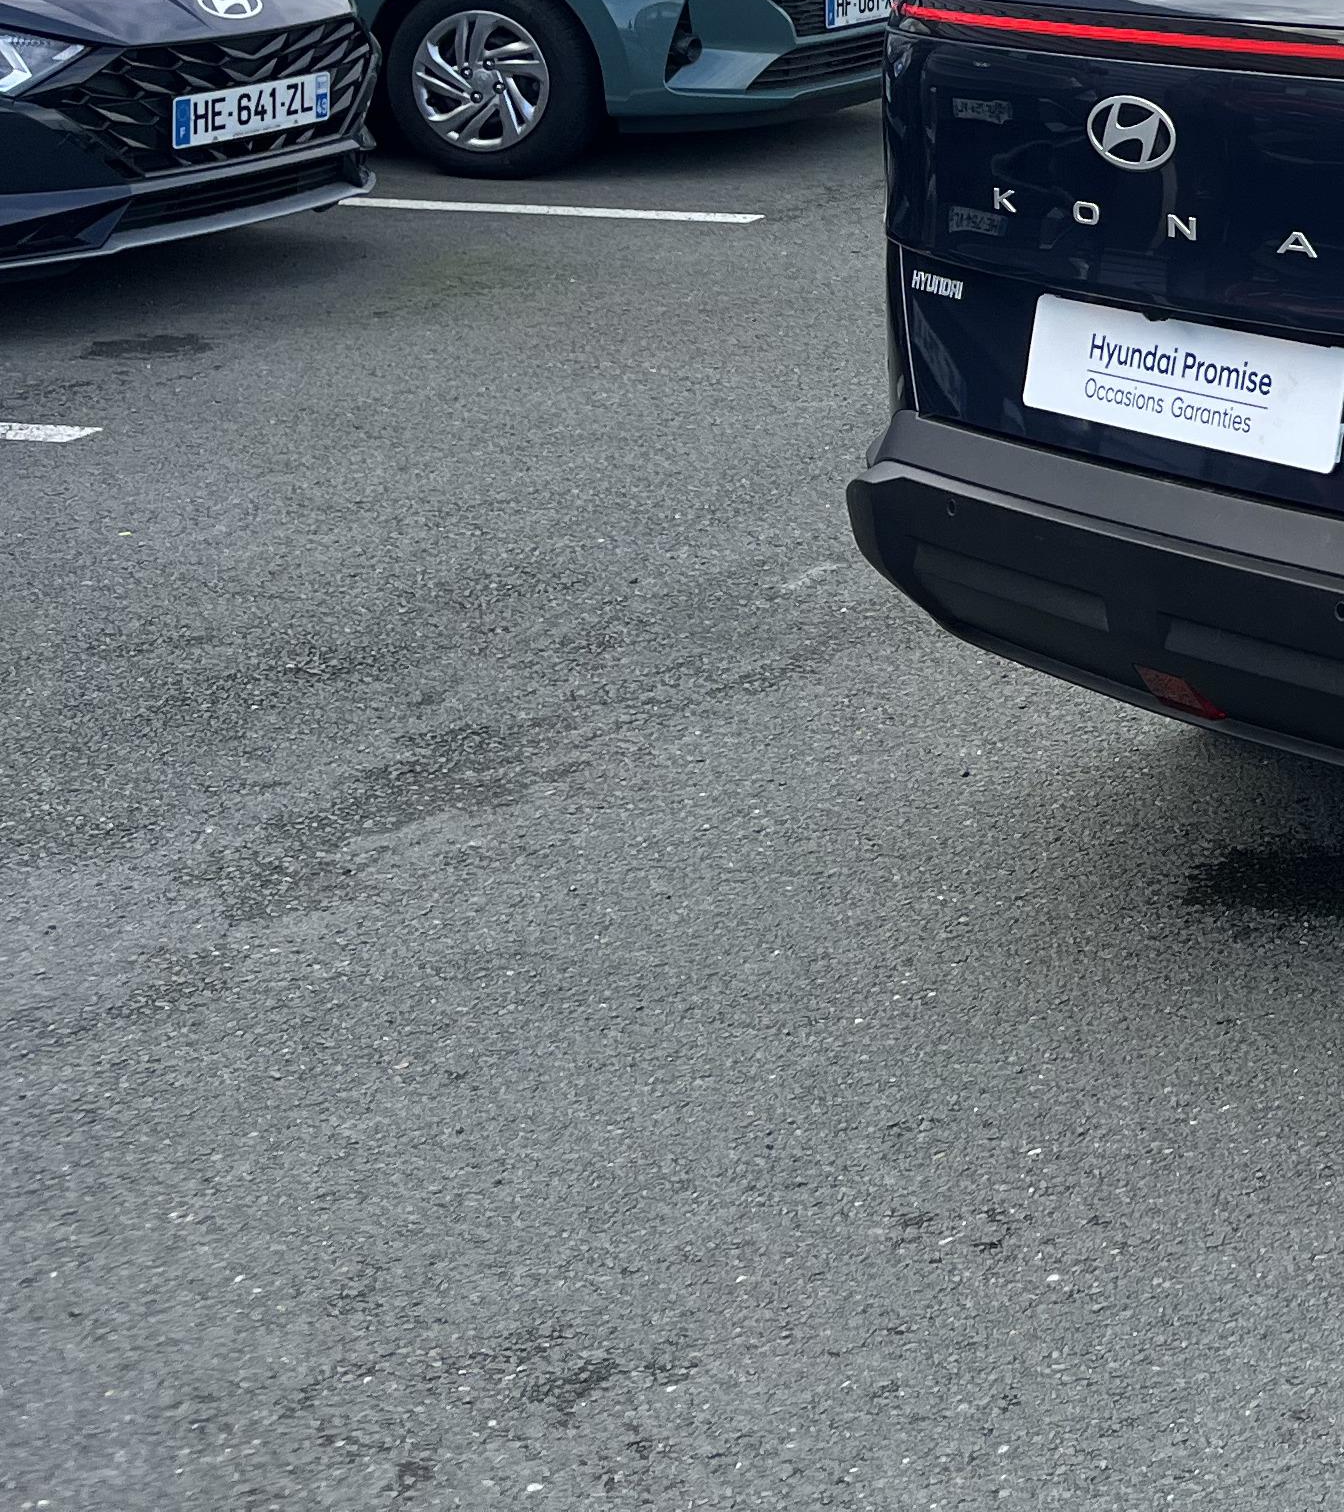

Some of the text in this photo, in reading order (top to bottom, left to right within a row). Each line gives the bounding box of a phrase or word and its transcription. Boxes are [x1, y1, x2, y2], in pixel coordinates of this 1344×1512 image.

[193, 82, 313, 135] HE-641-ZL
[993, 187, 1317, 259] KONA
[911, 269, 963, 300] HYUNDAI
[1089, 333, 1273, 396] Hyundai Promise
[1084, 377, 1251, 434] Occasions Garanties
